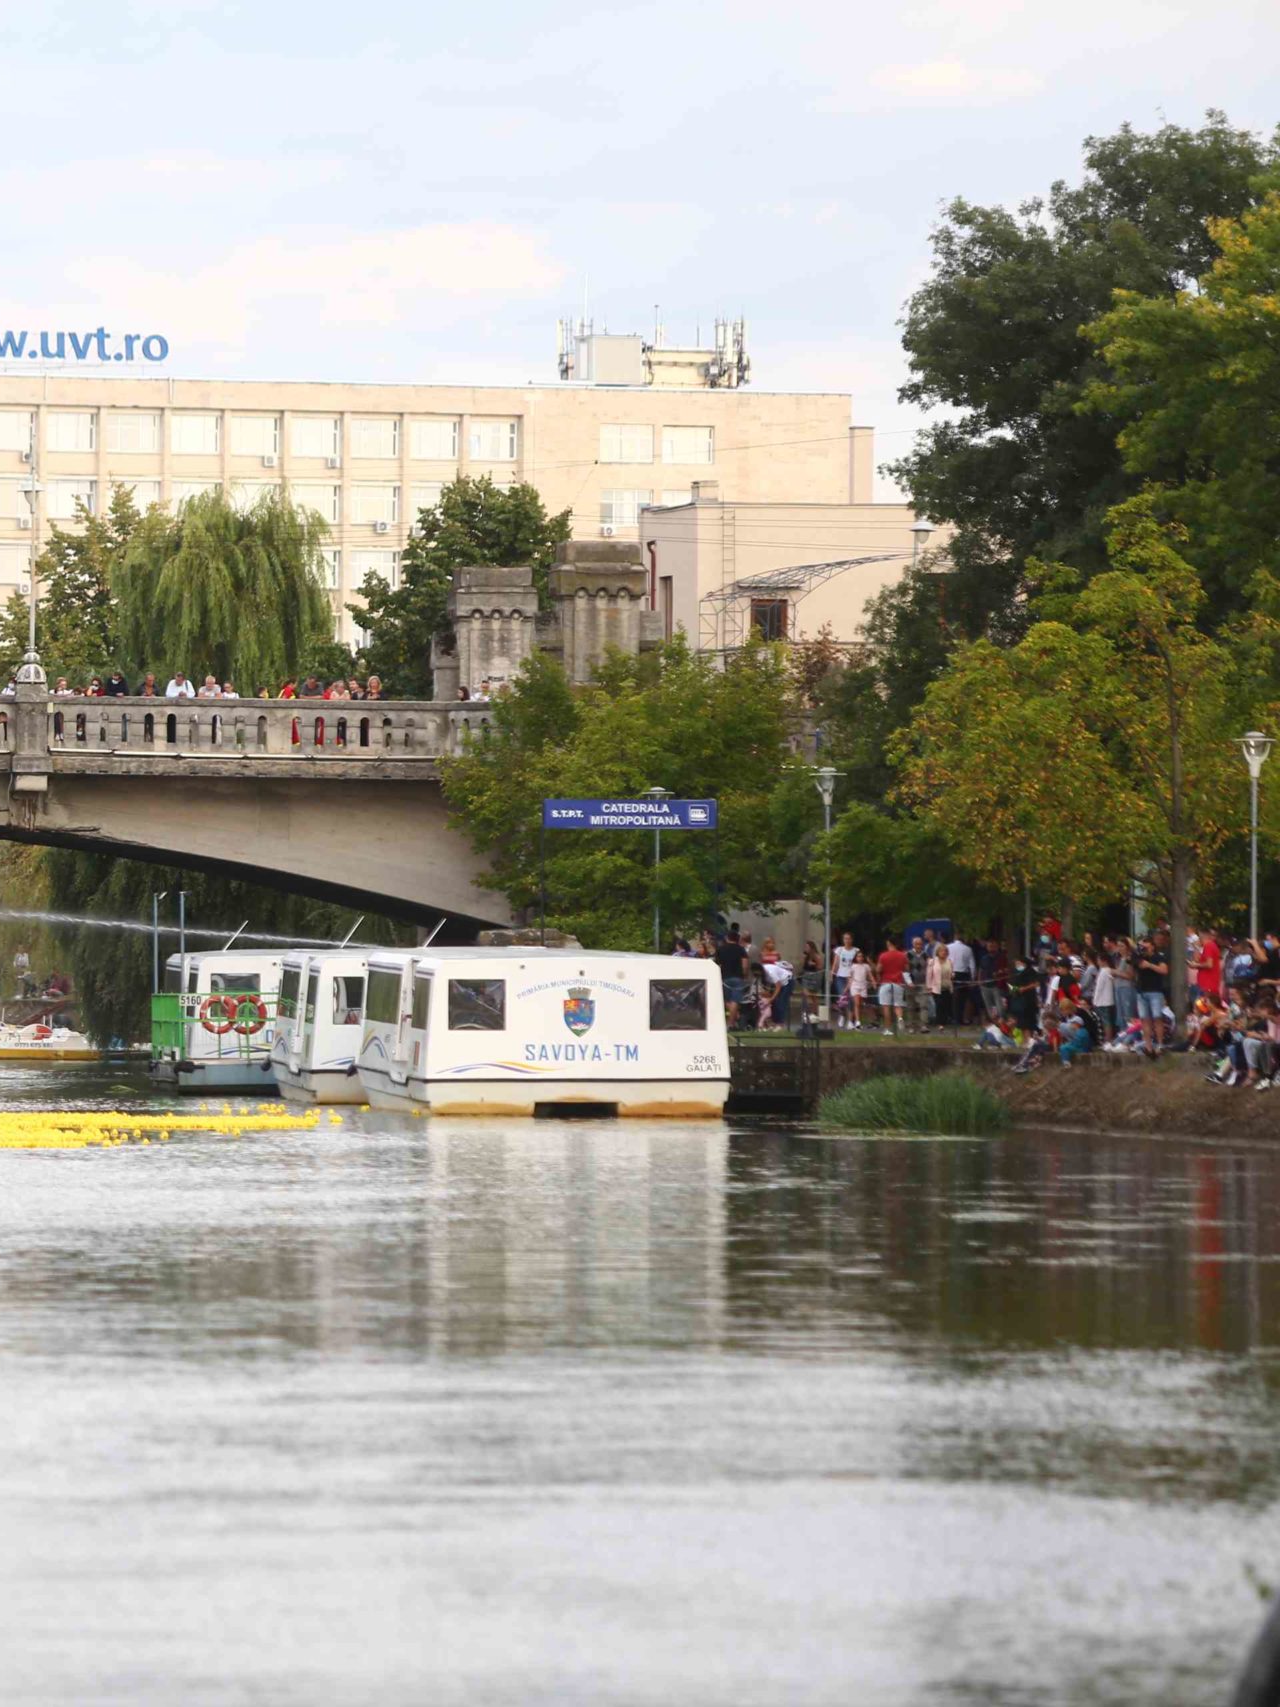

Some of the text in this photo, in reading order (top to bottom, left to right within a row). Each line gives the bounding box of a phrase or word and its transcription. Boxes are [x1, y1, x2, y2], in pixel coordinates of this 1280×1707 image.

[602, 803, 670, 813] CATEDRALA
[552, 810, 584, 818] S.T.P.T.
[590, 814, 682, 826] MITROPOLITANĂ
[180, 995, 202, 1005] 5160
[525, 1044, 639, 1061] SAVOYA-TM
[693, 1055, 716, 1064] 5268
